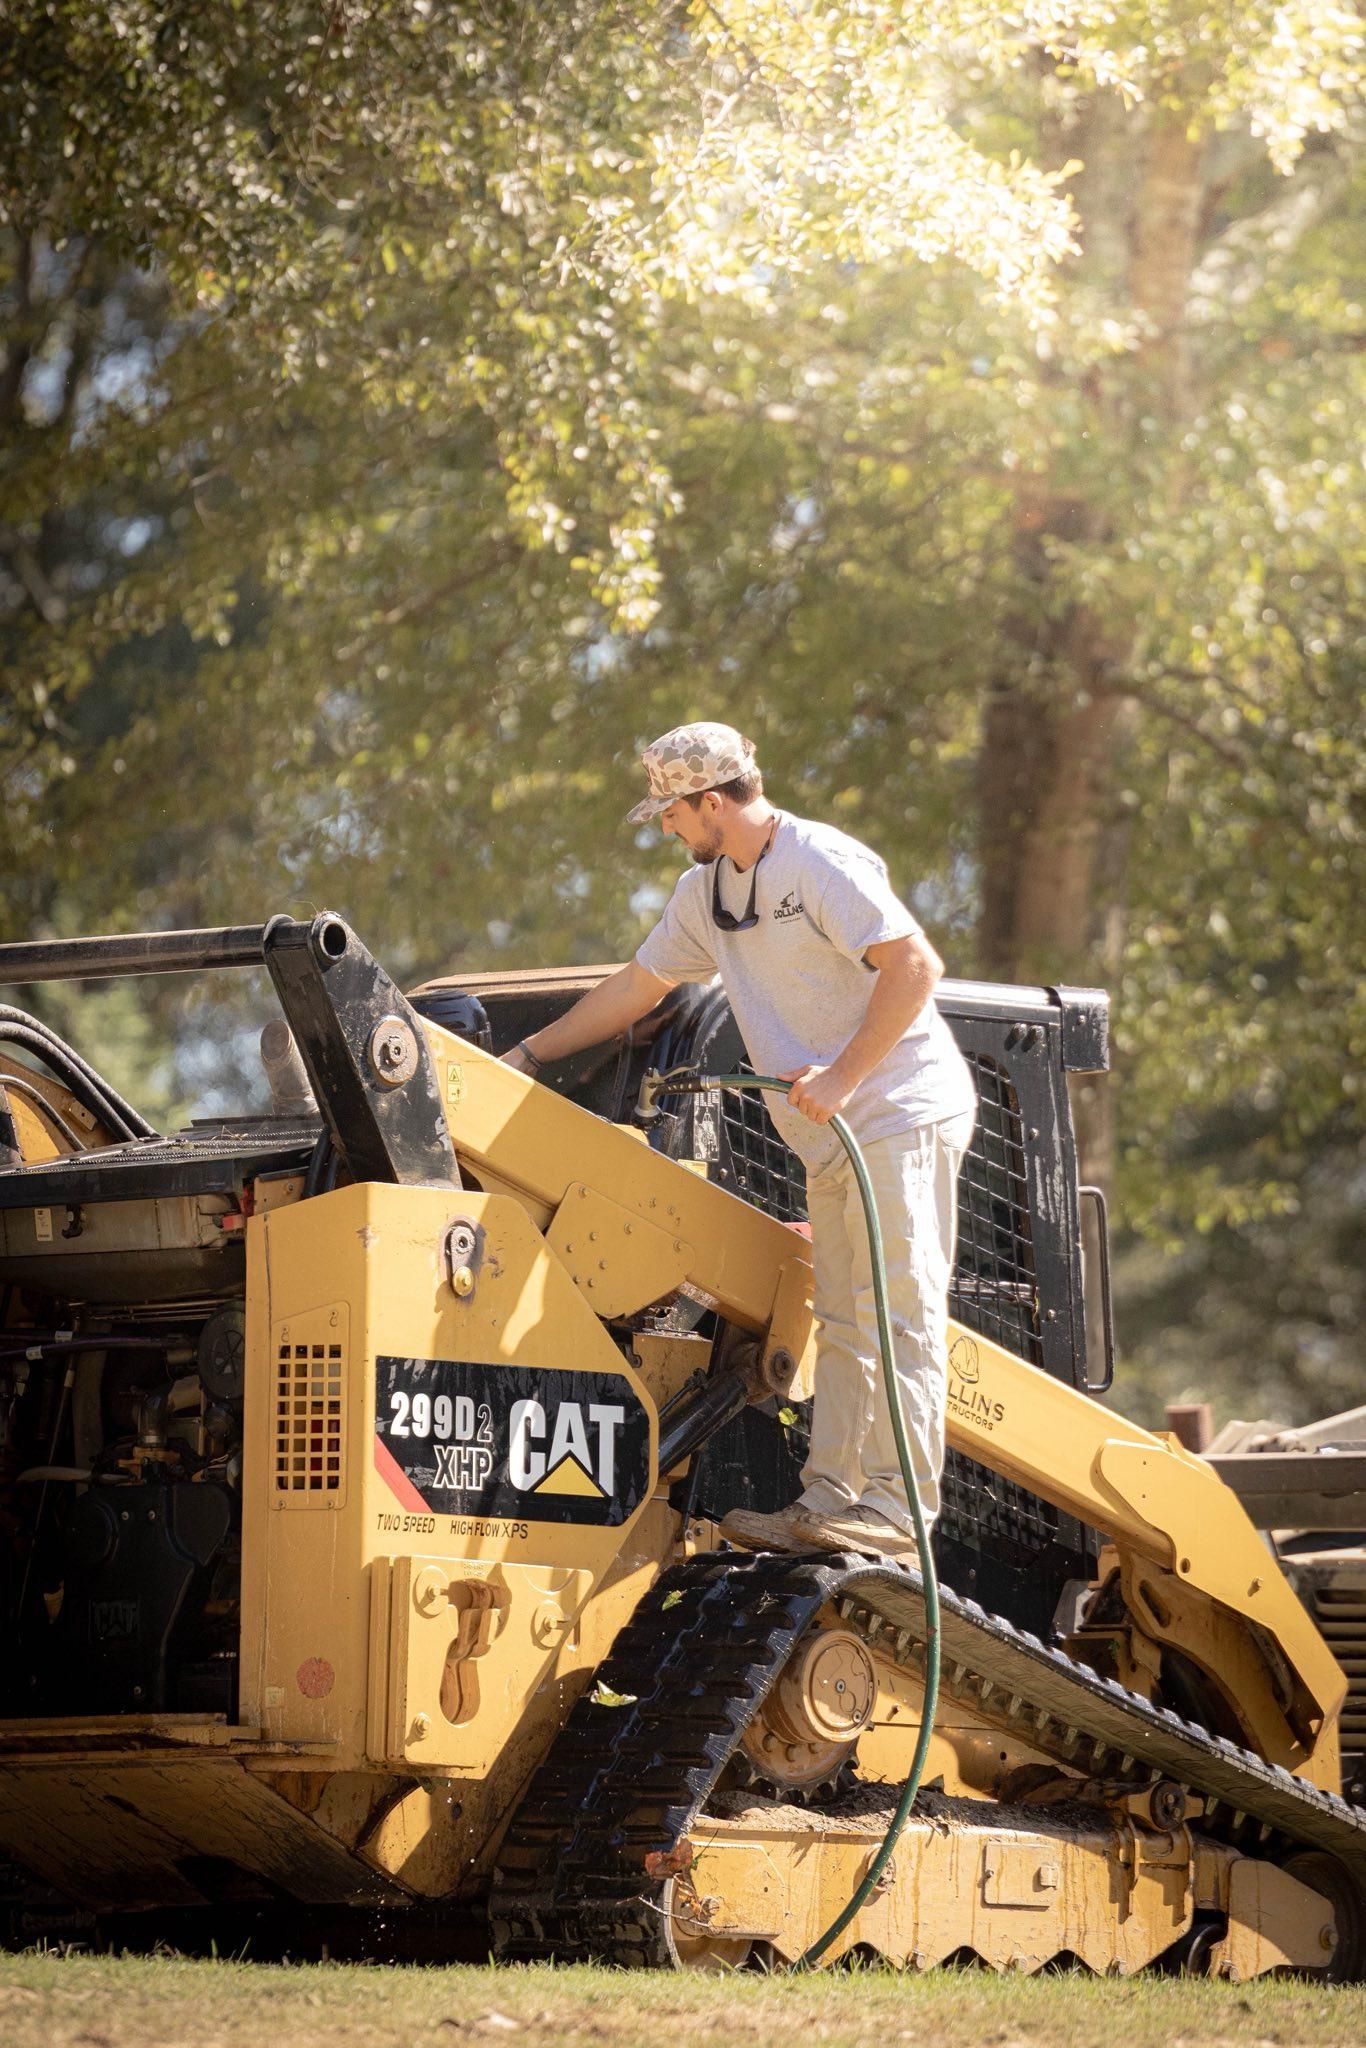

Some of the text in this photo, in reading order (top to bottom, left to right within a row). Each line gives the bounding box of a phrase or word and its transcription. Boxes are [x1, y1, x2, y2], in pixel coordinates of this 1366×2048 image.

[946, 1400, 994, 1431] TRUCTORS
[948, 1379, 1005, 1421] LLINS
[509, 1399, 624, 1497] CAT
[433, 1445, 492, 1491] XHP
[376, 1513, 436, 1534] TWO SPEED
[501, 1522, 529, 1539] XPS
